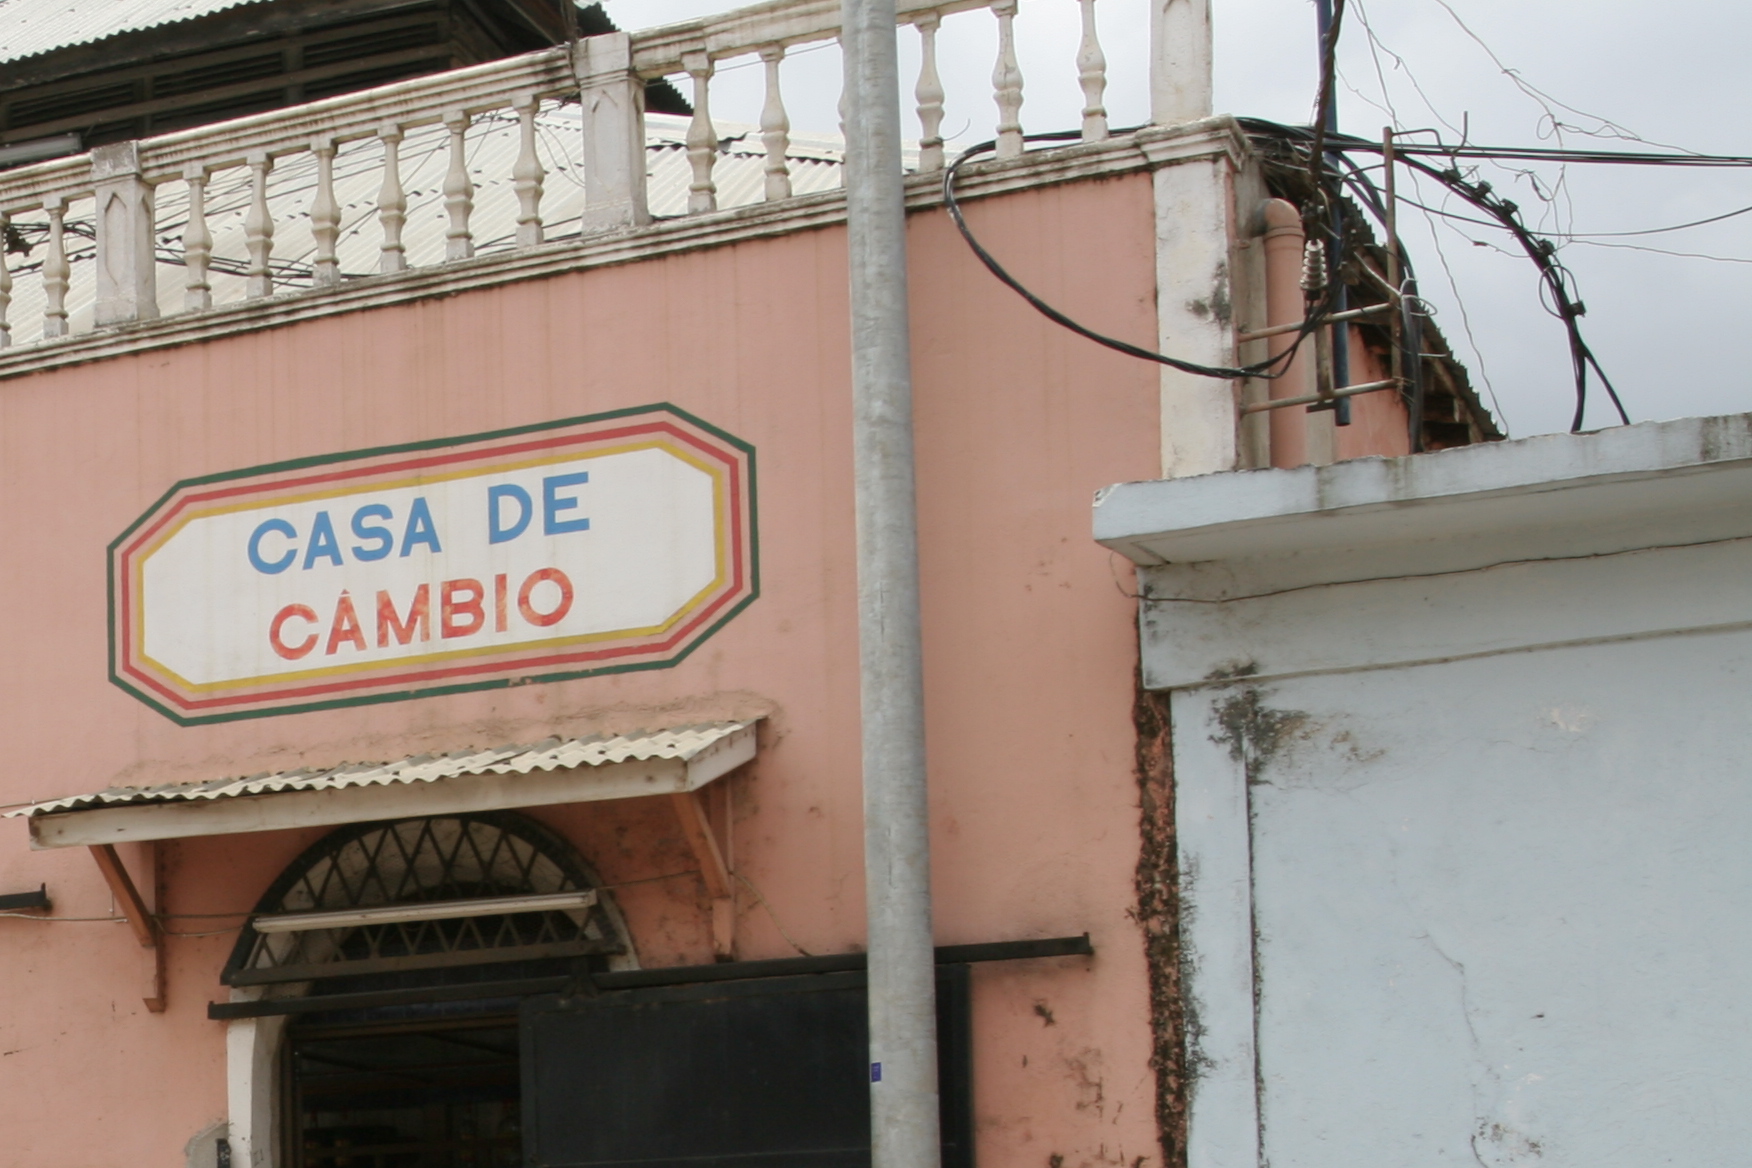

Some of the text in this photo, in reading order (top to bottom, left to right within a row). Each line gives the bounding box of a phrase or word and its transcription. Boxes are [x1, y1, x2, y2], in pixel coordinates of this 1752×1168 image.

[248, 471, 590, 575] CASA DE
[270, 567, 574, 661] CÂMBIO
